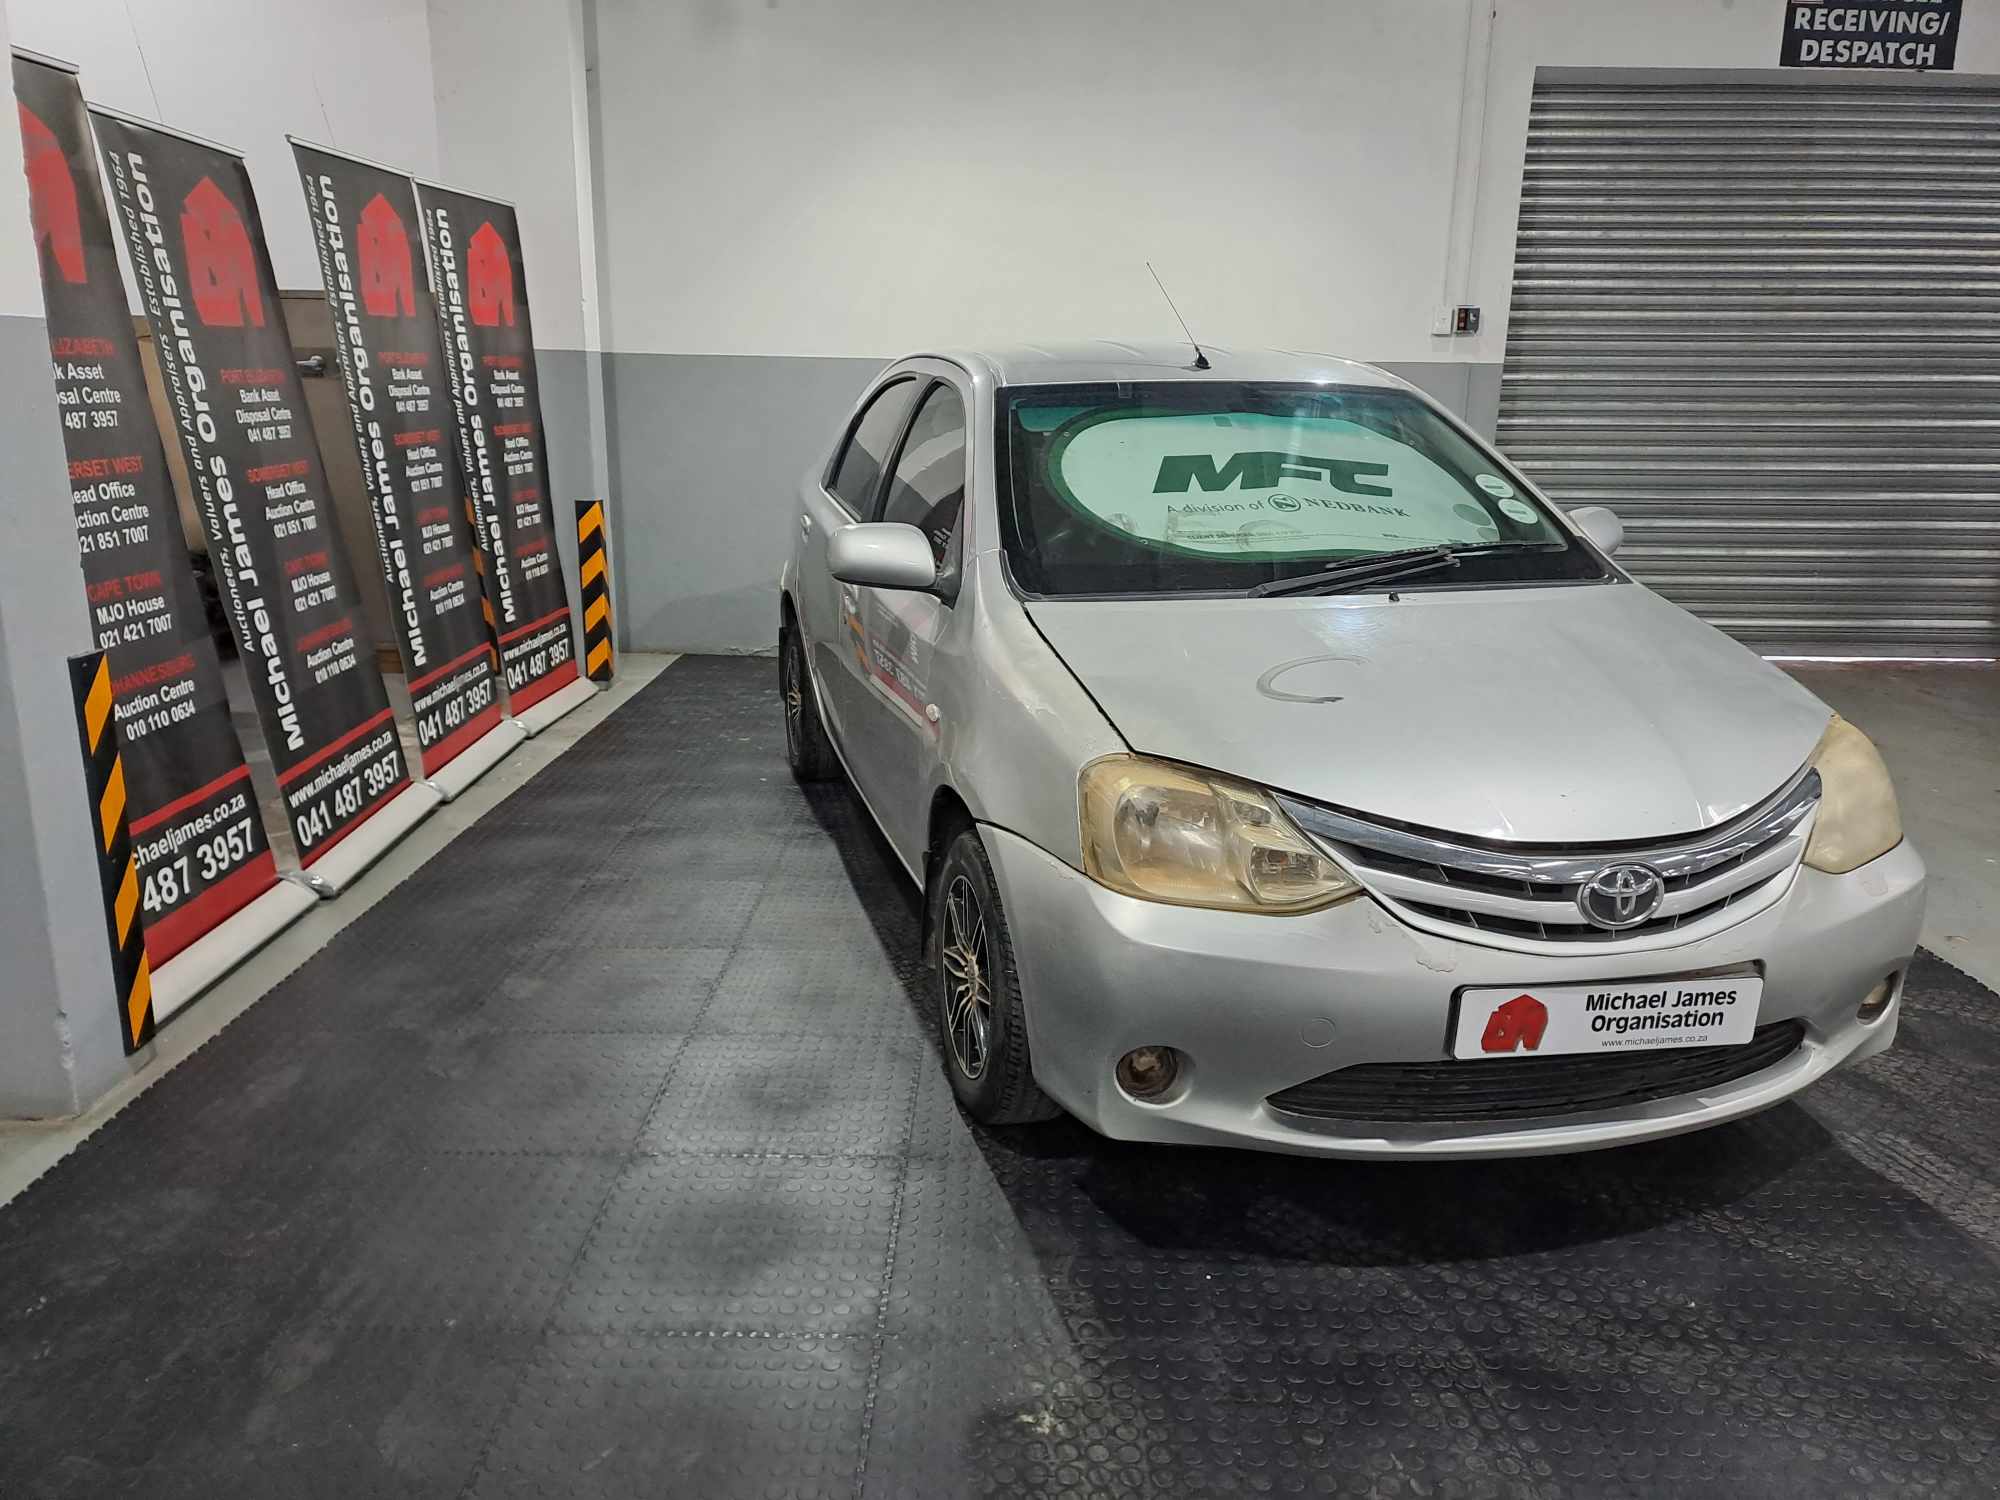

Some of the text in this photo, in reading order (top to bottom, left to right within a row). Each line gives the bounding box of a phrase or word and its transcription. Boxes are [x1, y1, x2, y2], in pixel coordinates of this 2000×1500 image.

[1793, 7, 1951, 36] RECEIVING/
[1799, 39, 1936, 66] DESPATCH
[108, 150, 131, 199] 1964
[122, 205, 162, 317] Established
[67, 362, 104, 380] Asset
[158, 334, 193, 431] Appraisers
[81, 386, 121, 404] Centre
[436, 208, 516, 624] Michael James Organisation
[453, 399, 466, 424] and
[65, 410, 118, 429] 487 3957
[319, 175, 427, 667] Michael James Organisation
[349, 403, 363, 432] and
[127, 152, 305, 752] Michael James Organisation
[184, 434, 204, 470] and
[358, 436, 375, 491] Valuers
[459, 427, 474, 473] Valuers
[98, 481, 136, 501] Office
[1152, 451, 1393, 497] MFC
[111, 504, 150, 523] Centre
[198, 475, 223, 540] Valuers
[1167, 504, 1177, 514] A
[1182, 502, 1246, 514] division
[1248, 499, 1265, 511] of
[1303, 497, 1411, 518] NEDBANK
[97, 531, 121, 549] 851
[122, 525, 149, 545] 7007
[96, 595, 166, 625] MJO House
[219, 547, 255, 652] Auctioneers,
[99, 613, 173, 650] 021 421 7007
[506, 638, 569, 690] 041 487 3957
[114, 679, 196, 722] Auction Centre
[126, 699, 196, 741] 010 110 0634
[418, 678, 491, 747] 041 487 3957
[288, 731, 393, 809] www.michaeljames.co.za
[296, 750, 400, 847] 041 487 3957
[142, 816, 254, 912] 487 3957
[1585, 989, 1737, 1012] Michael James
[1591, 1009, 1724, 1034] Organisation
[1601, 1034, 1708, 1047] www.michaeljames.co.za
